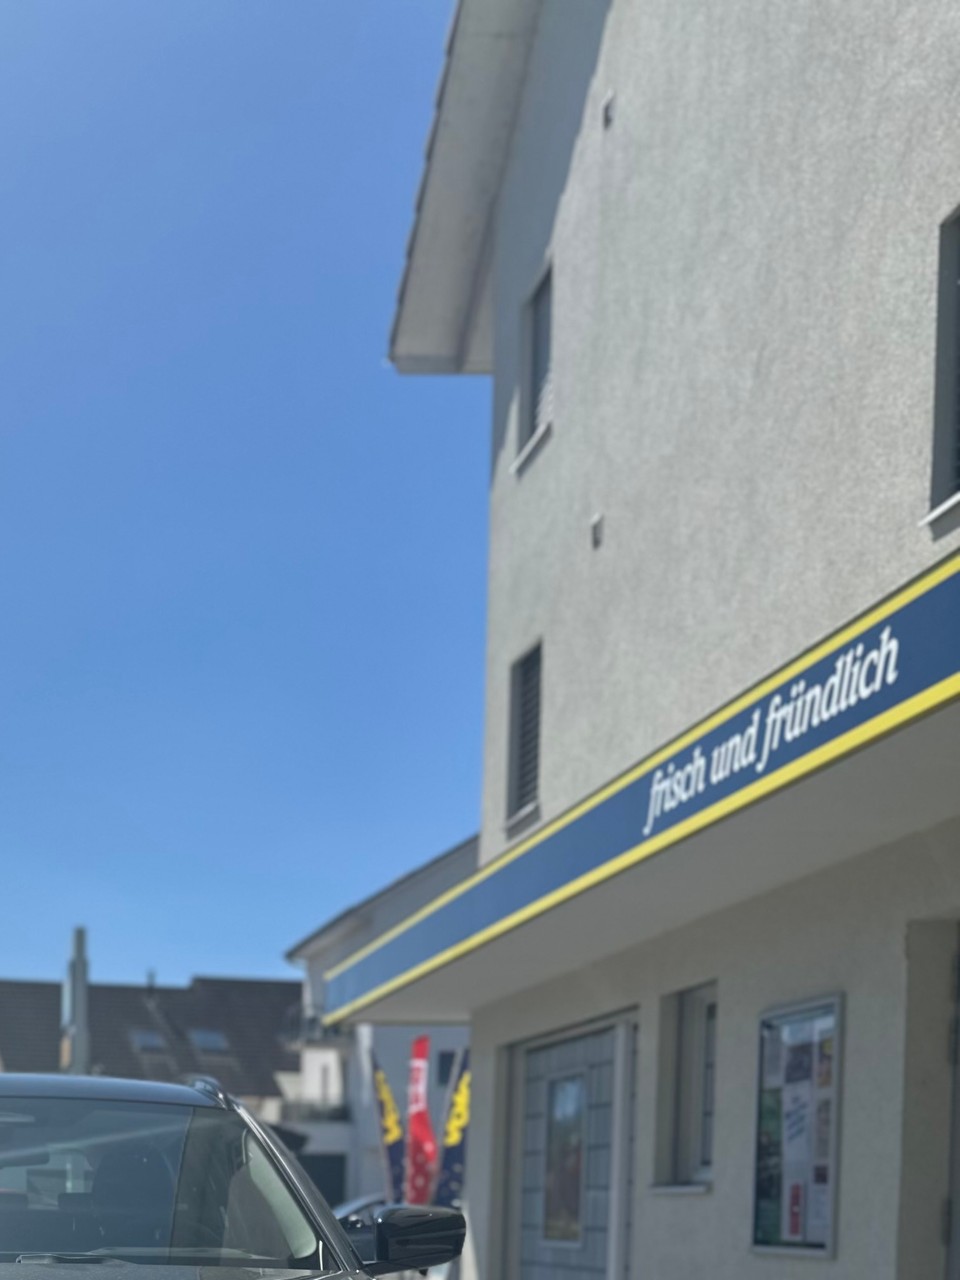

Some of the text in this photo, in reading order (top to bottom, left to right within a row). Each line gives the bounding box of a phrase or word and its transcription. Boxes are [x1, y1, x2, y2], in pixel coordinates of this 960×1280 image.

[642, 625, 900, 836] frisch und fründlich
